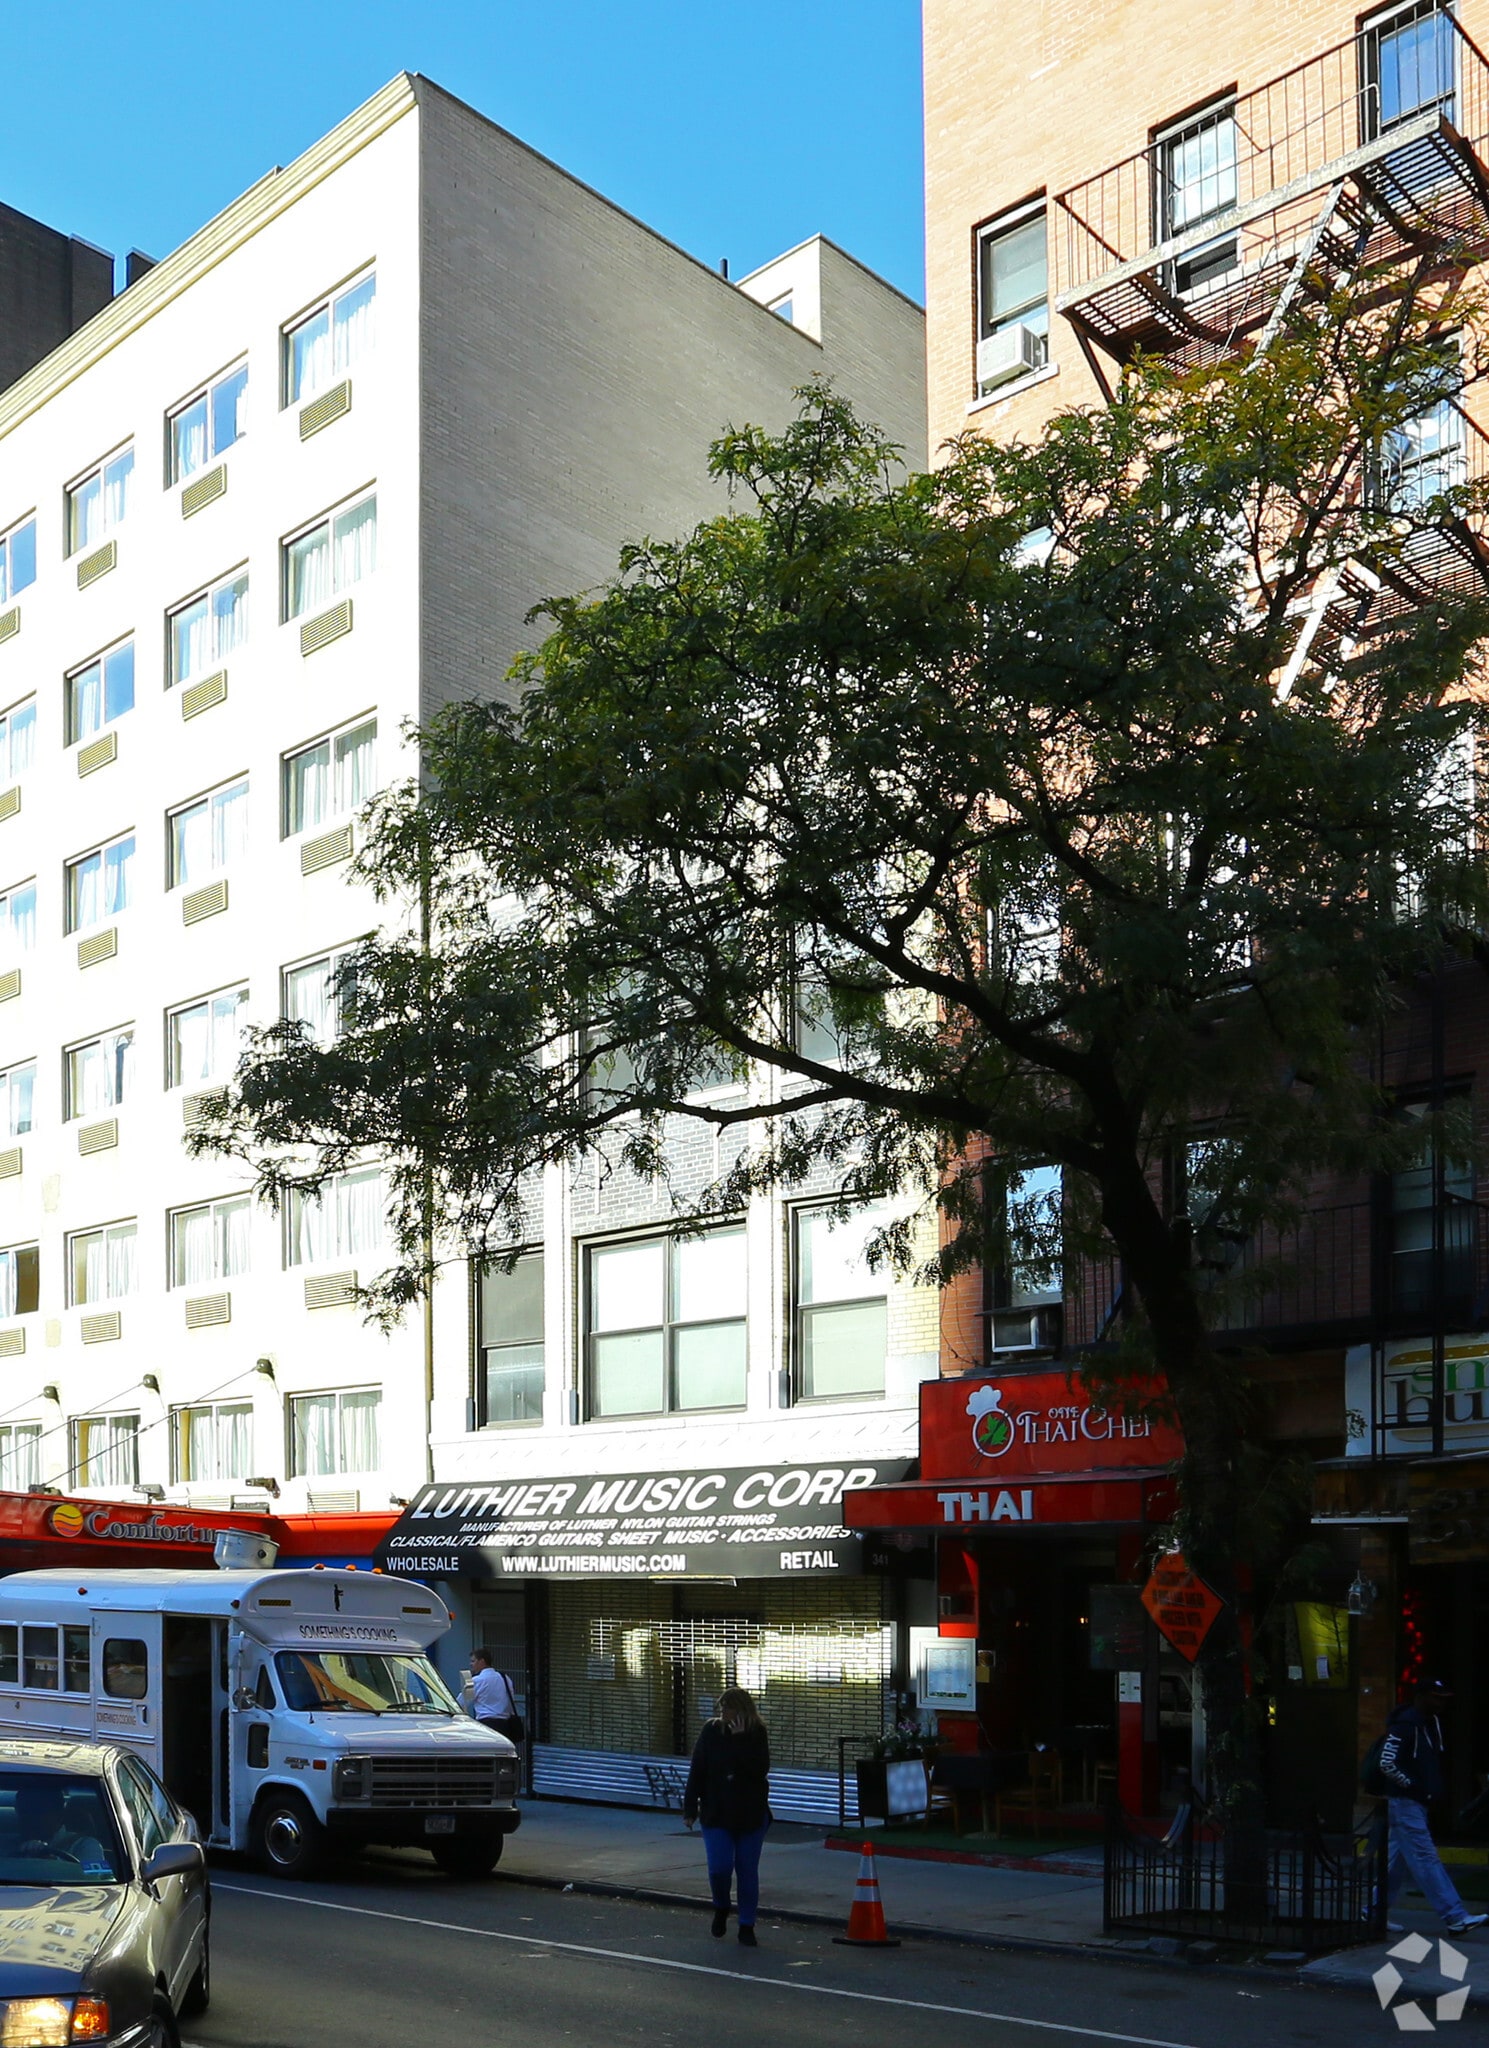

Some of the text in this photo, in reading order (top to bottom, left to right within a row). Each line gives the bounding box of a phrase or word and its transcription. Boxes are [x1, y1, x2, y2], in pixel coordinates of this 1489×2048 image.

[411, 1468, 877, 1519] LUTHIER MUSIC CORP
[936, 1490, 1034, 1522] THAI
[86, 1510, 200, 1543] Comfort
[459, 1513, 778, 1533] MANUFACTURER OF LUTHIER NYLON GUITAR STRINGS
[390, 1525, 852, 1548] CLASSICAL/FLAMENCO GUITARS, SHEET MUSIC ACCESSORIES
[386, 1550, 839, 1573] WHOLESALE WWW.LUTHIERMUSIC.COM RETAIL
[299, 1624, 398, 1642] SOMETHING'S COOKING
